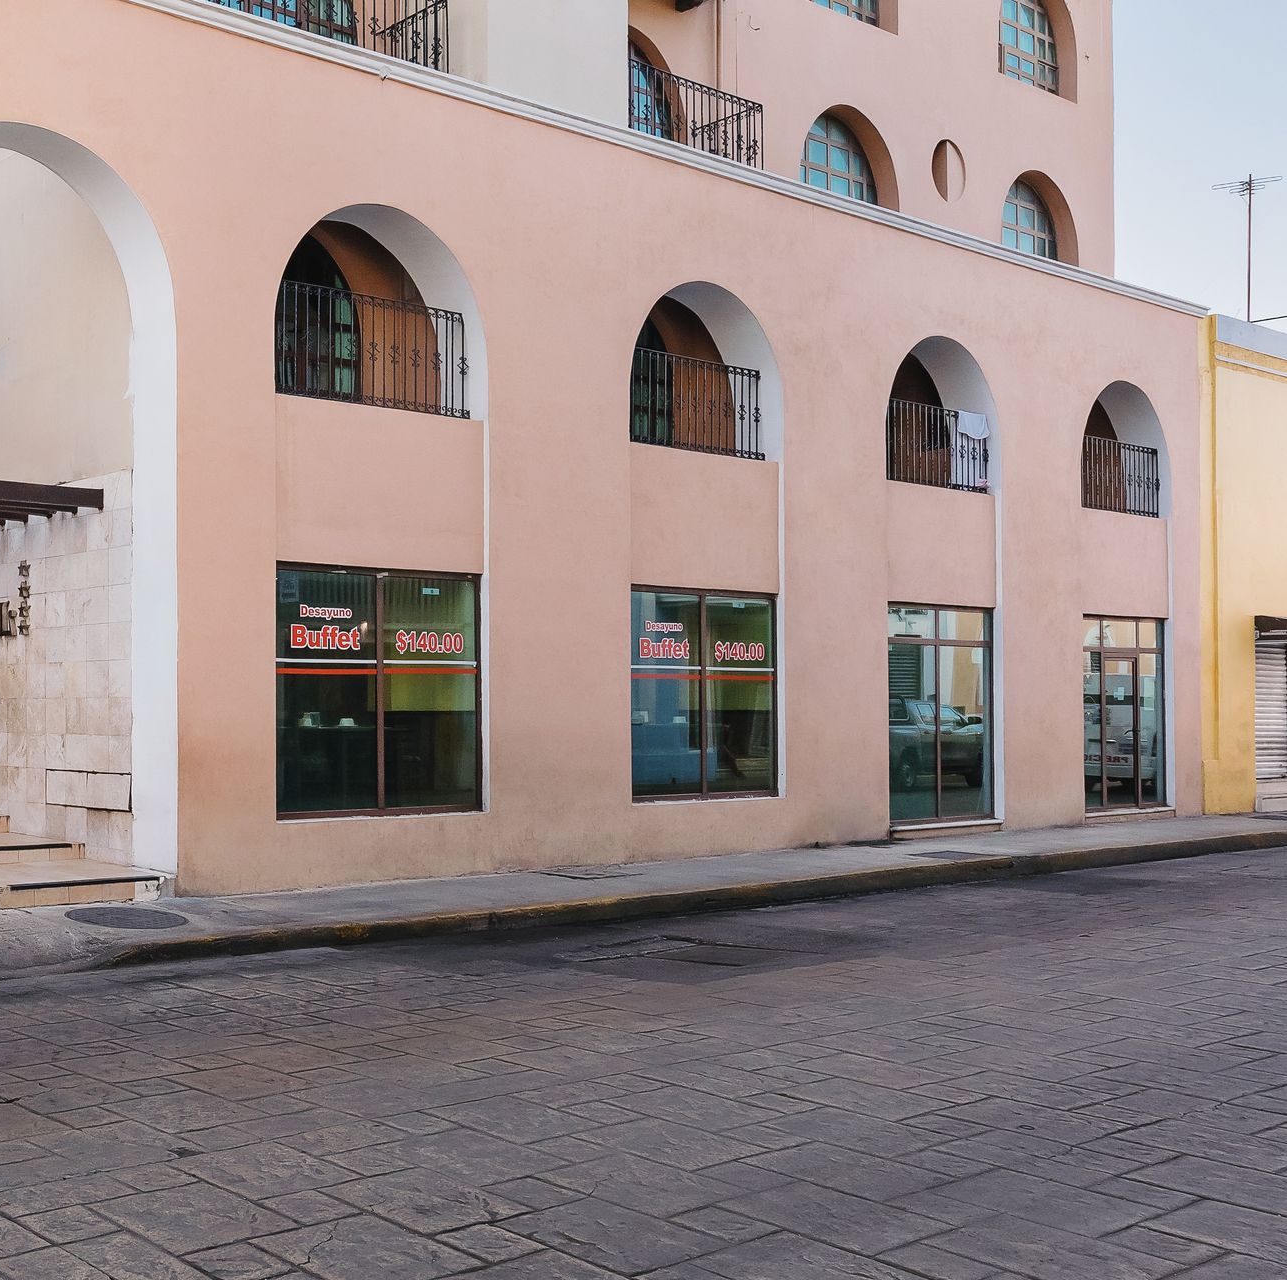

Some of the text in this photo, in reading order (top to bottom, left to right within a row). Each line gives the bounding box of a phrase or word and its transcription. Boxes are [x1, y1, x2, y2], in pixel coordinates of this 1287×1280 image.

[300, 604, 352, 619] Desayuno
[645, 621, 683, 631] Desayuno
[291, 624, 360, 650] Buffet
[396, 630, 463, 654] $140.00
[639, 638, 689, 659] Buffet
[715, 641, 764, 662] $140.00
